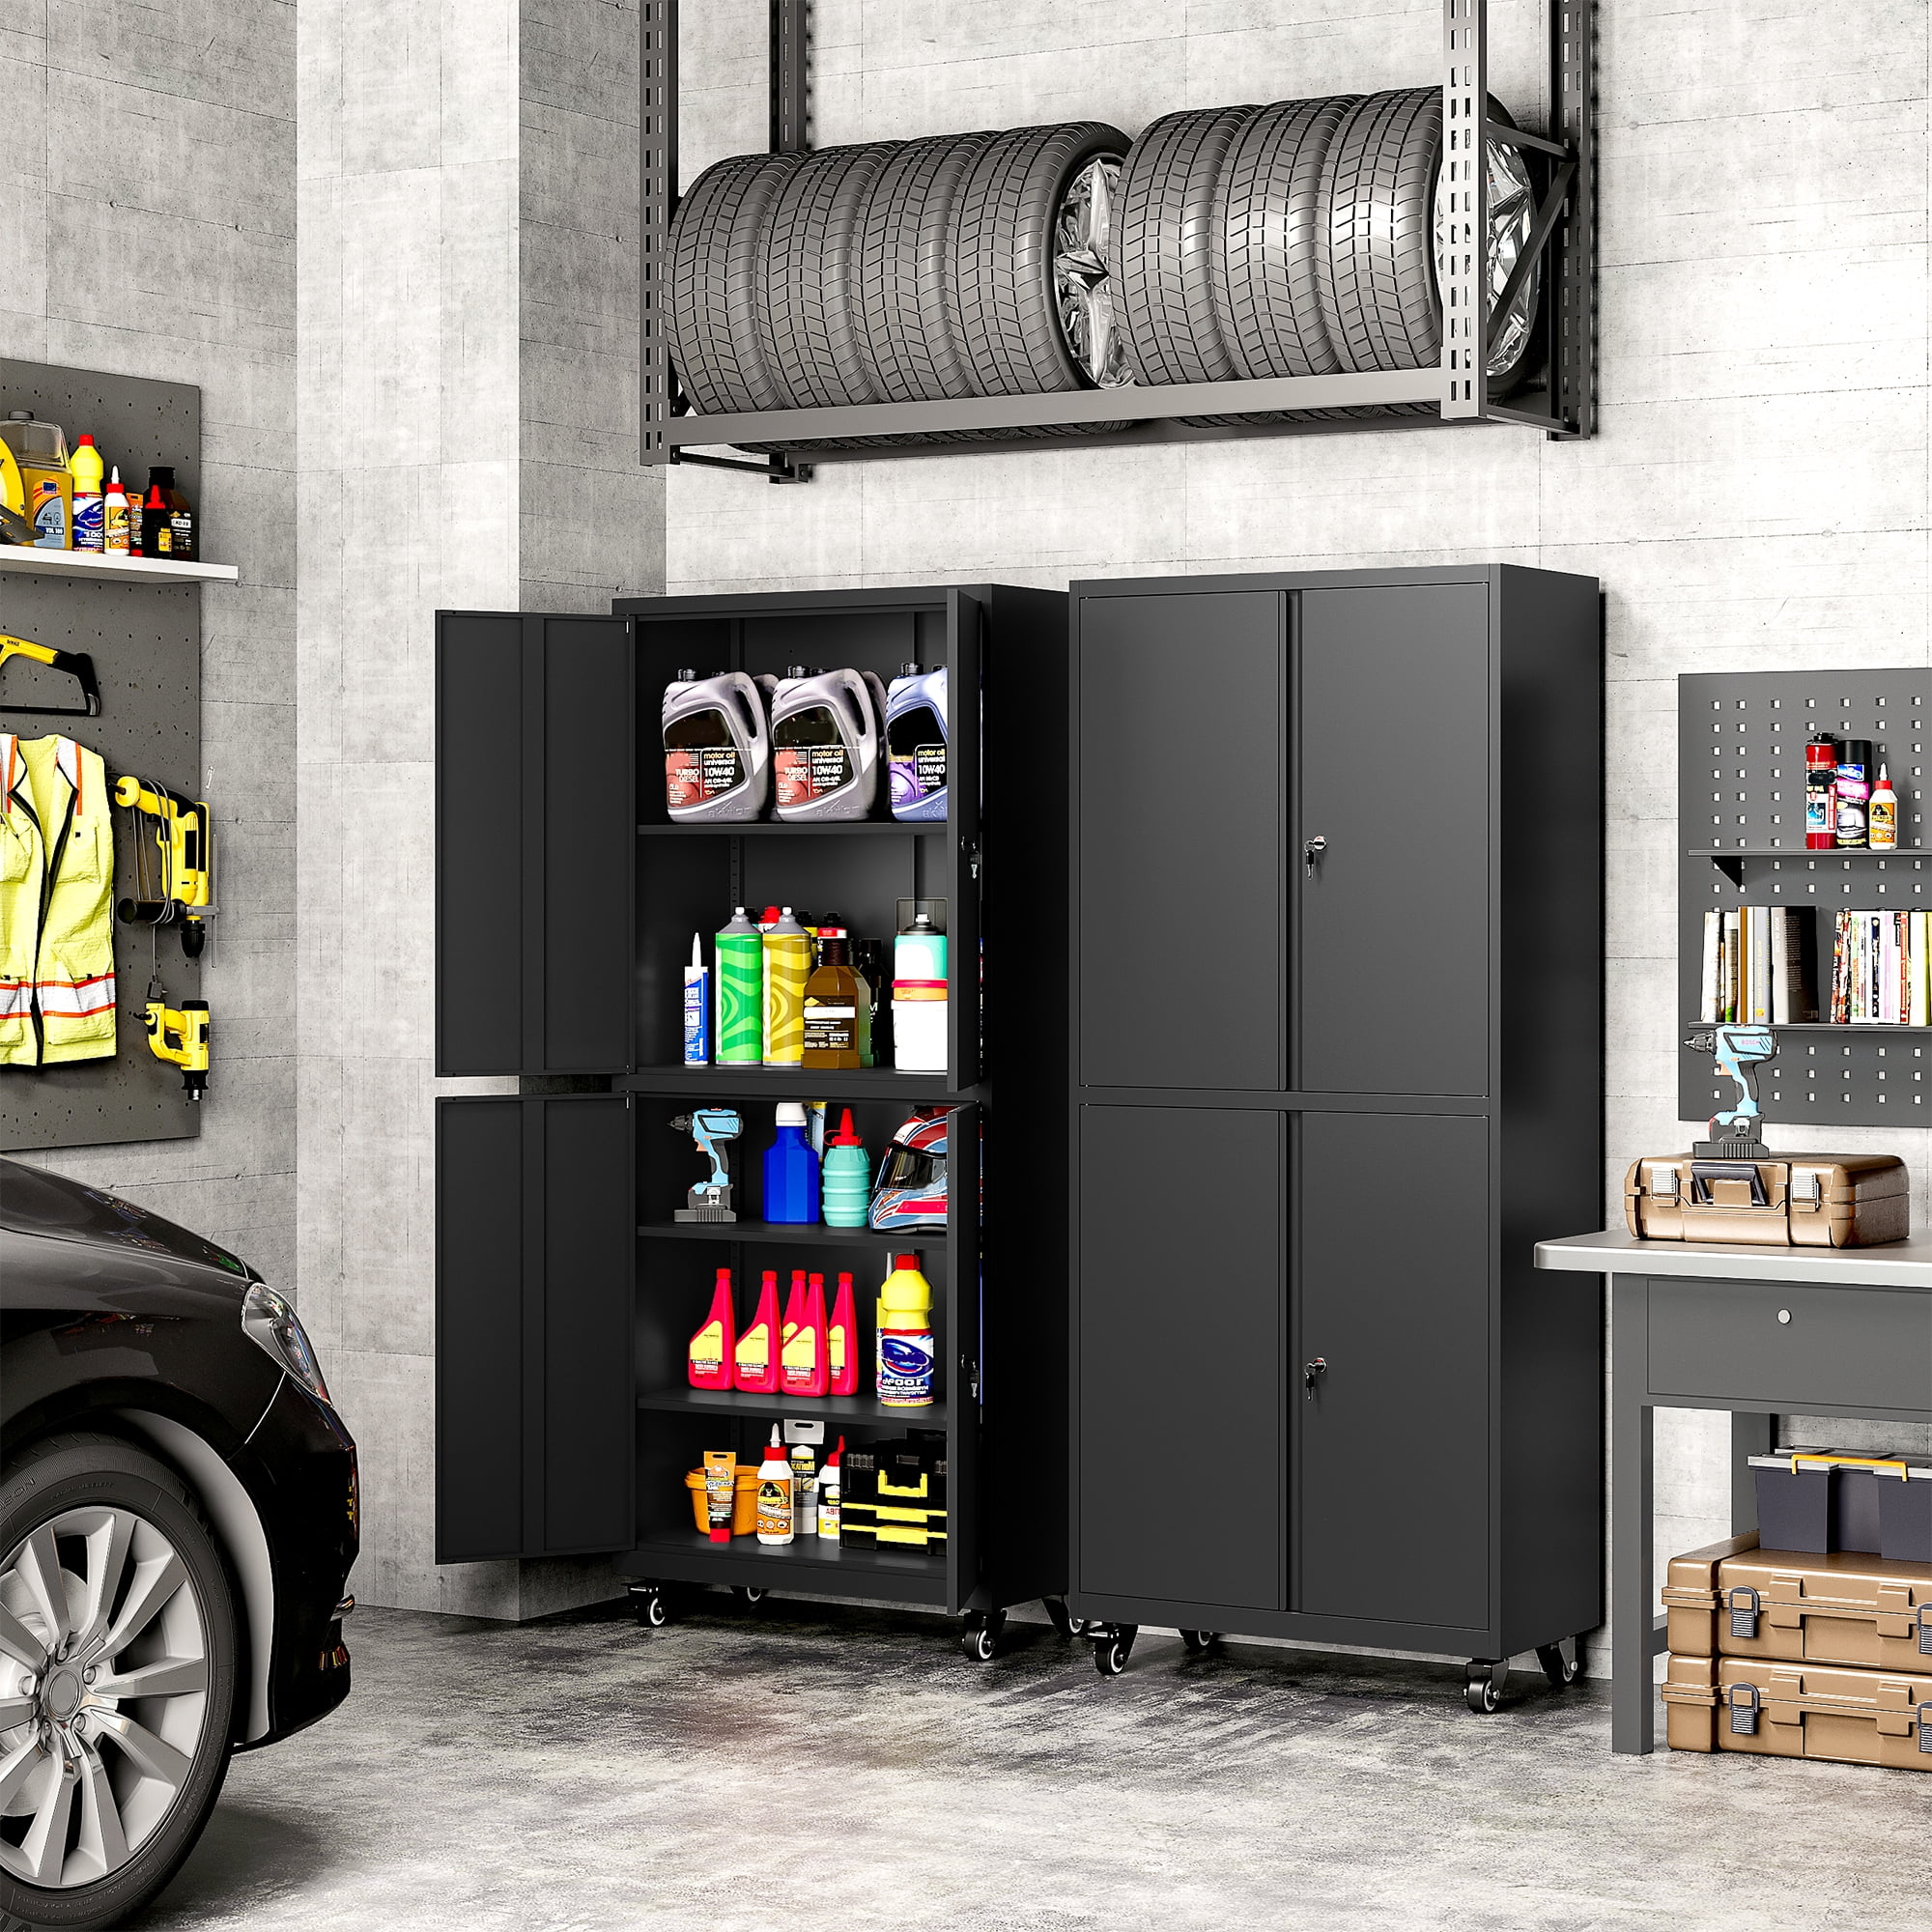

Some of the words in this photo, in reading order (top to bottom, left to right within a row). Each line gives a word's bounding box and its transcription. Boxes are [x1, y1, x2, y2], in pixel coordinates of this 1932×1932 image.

[703, 766, 735, 777] 10W40
[811, 765, 842, 775] 10W40
[918, 764, 946, 775] 10W40
